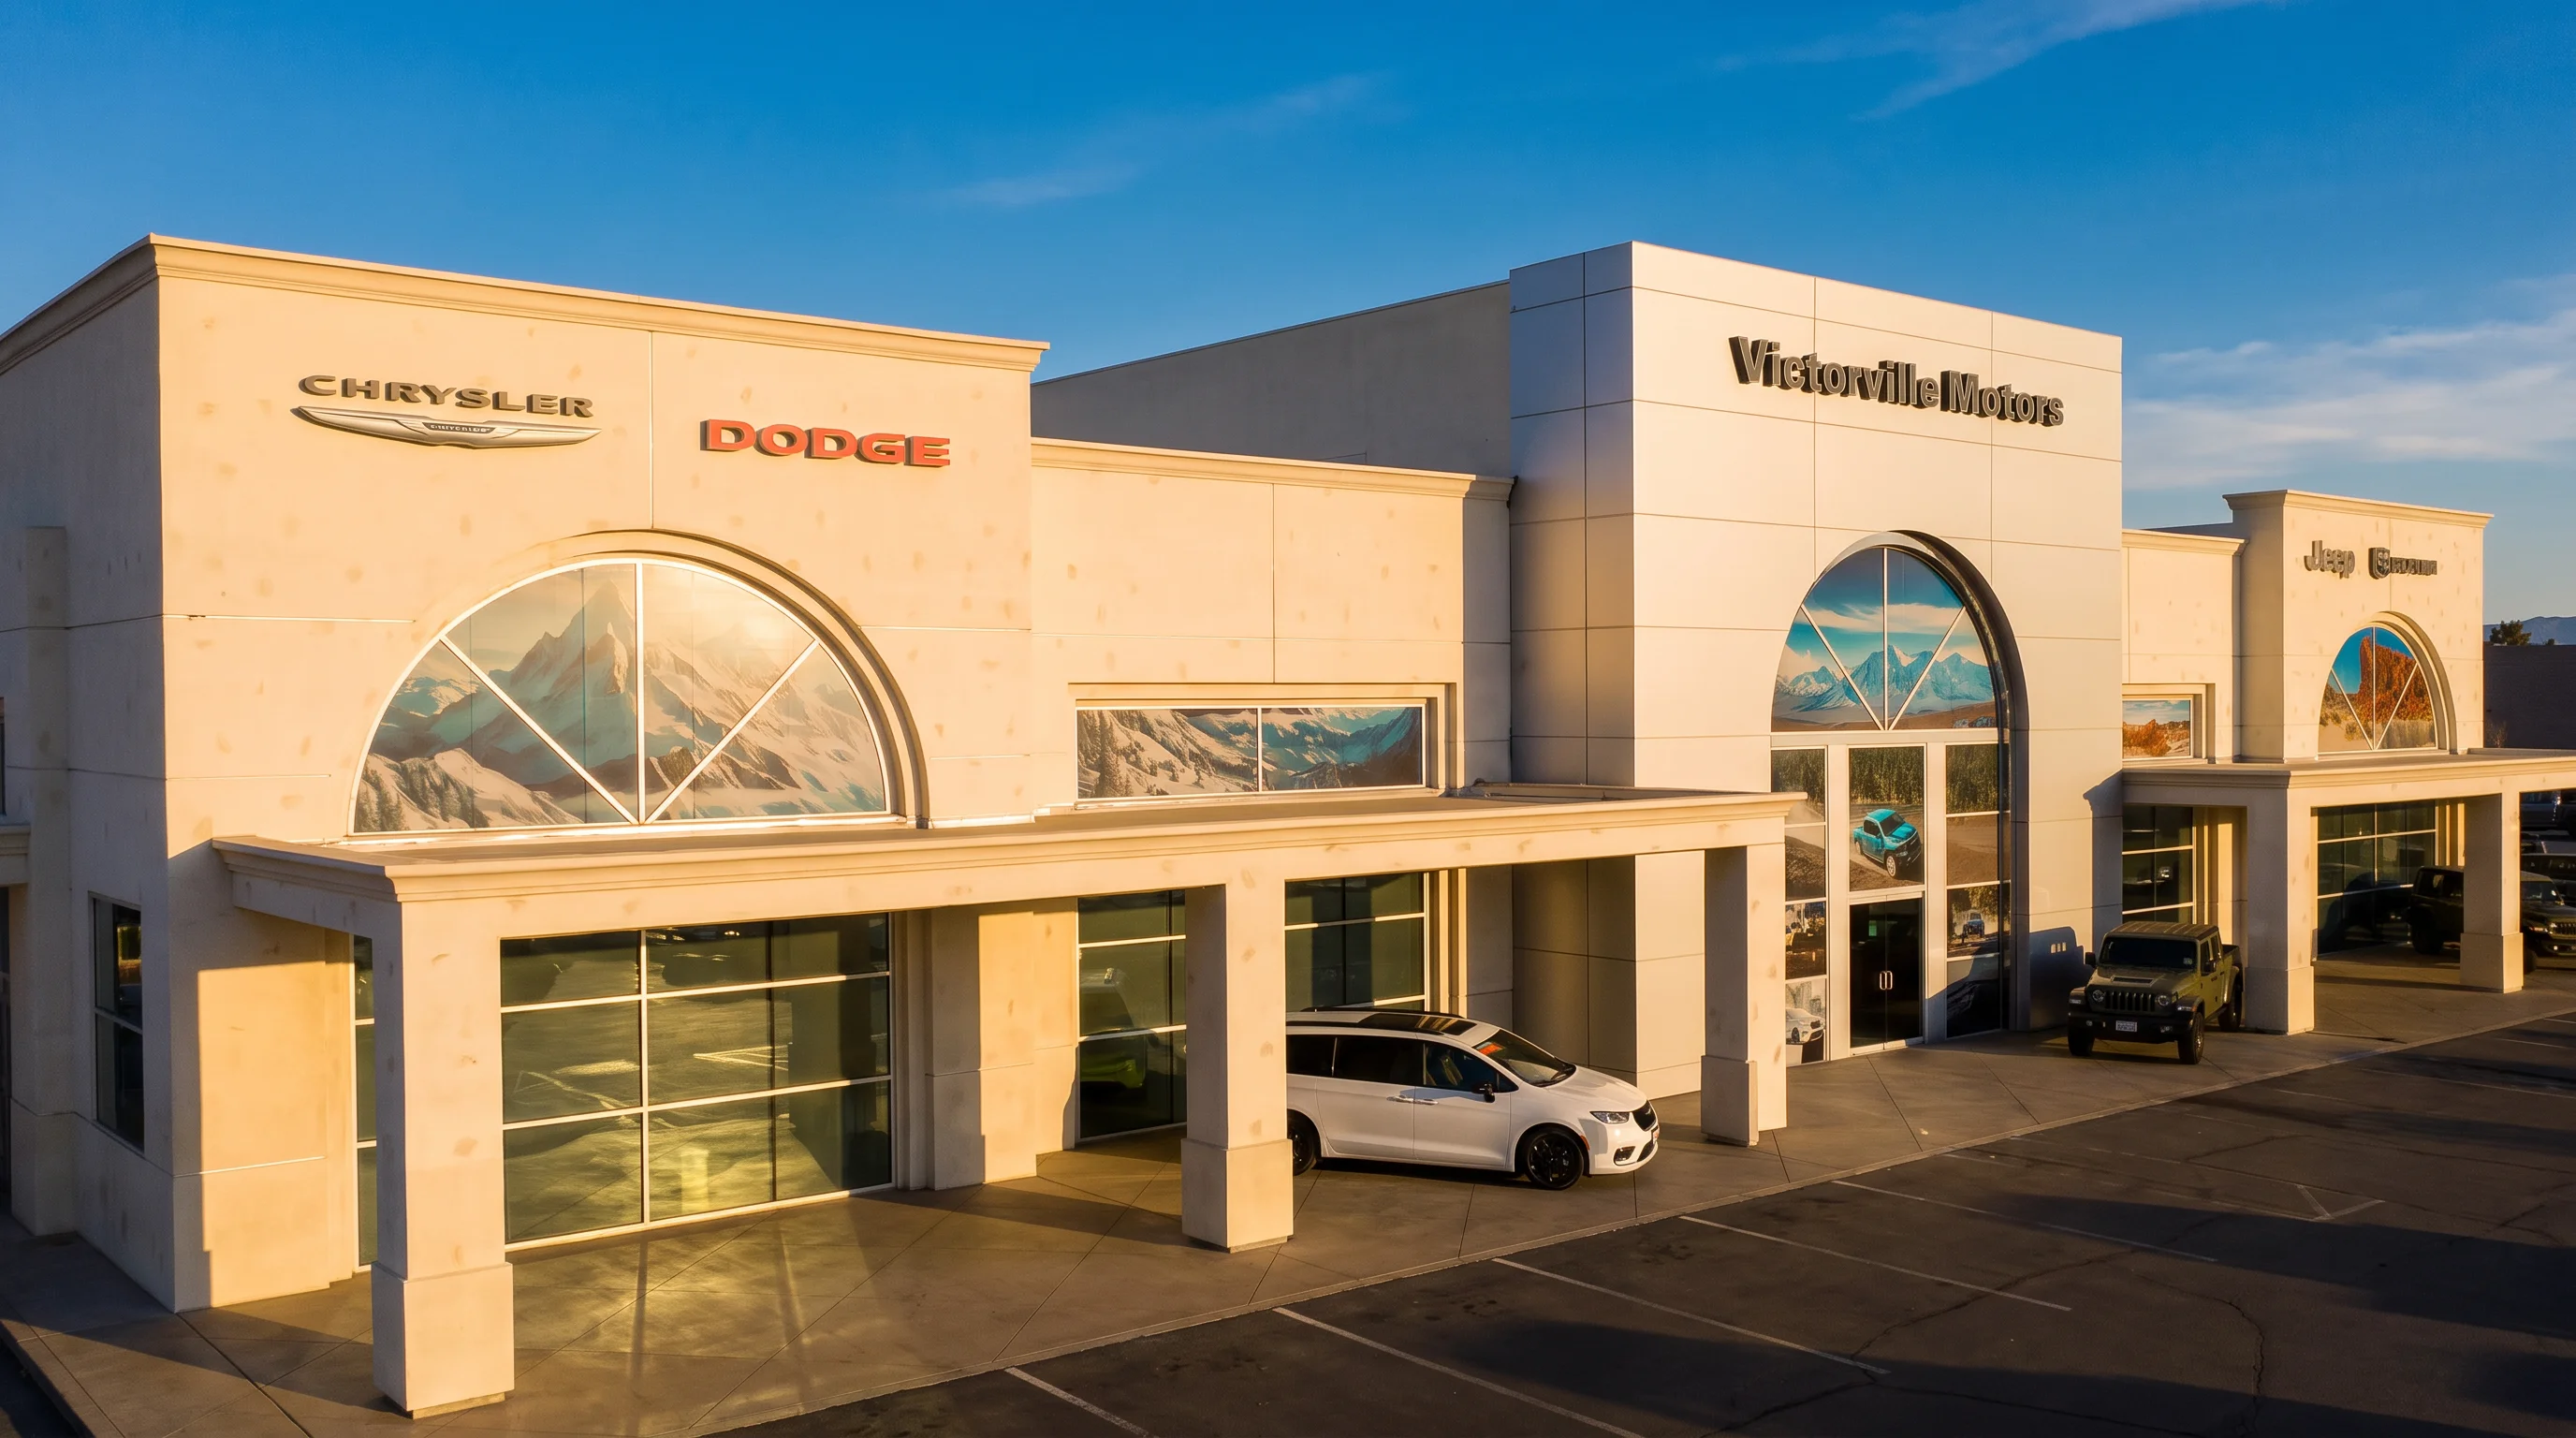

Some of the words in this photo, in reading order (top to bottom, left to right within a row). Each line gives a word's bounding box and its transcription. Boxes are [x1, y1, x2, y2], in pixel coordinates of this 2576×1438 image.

[299, 374, 593, 418] CHRYSLER
[1729, 335, 1939, 408] Victorville
[1940, 370, 2064, 427] Motors
[700, 418, 950, 468] DODGE
[2304, 540, 2356, 580] Jeep
